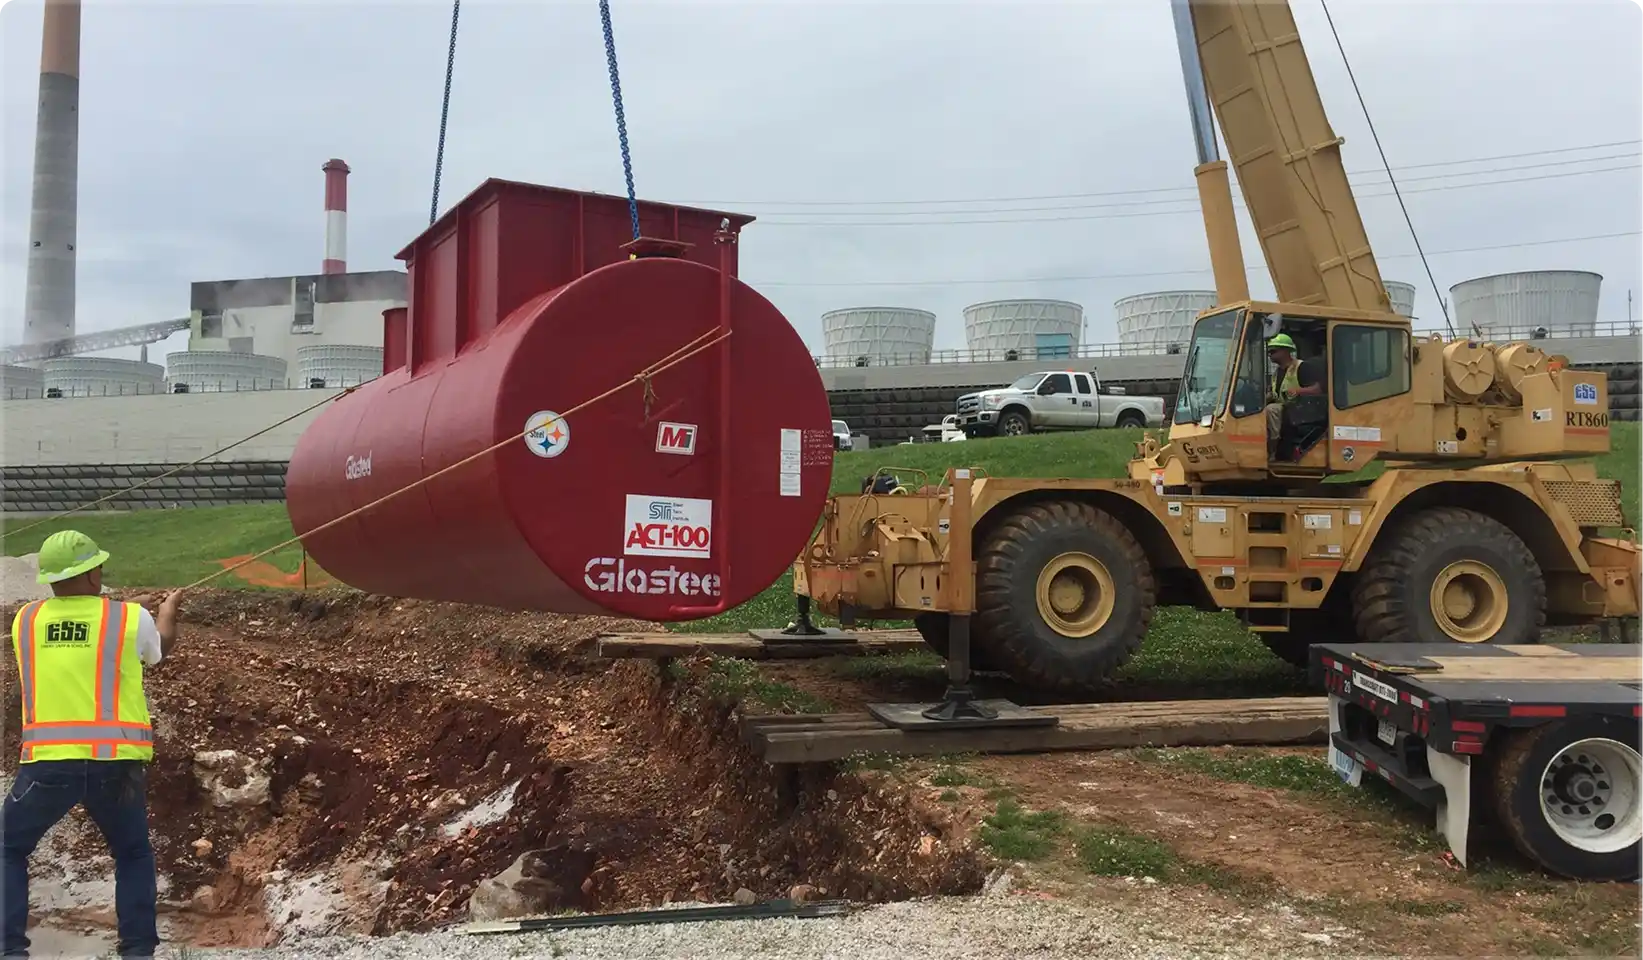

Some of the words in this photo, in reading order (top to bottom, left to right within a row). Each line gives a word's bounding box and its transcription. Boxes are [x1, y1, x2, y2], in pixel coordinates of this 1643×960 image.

[1575, 384, 1596, 399] ESS
[1566, 411, 1608, 427] RT860
[626, 523, 710, 549] ACT-100
[584, 557, 721, 596] Glastee
[47, 621, 87, 641] ESS
